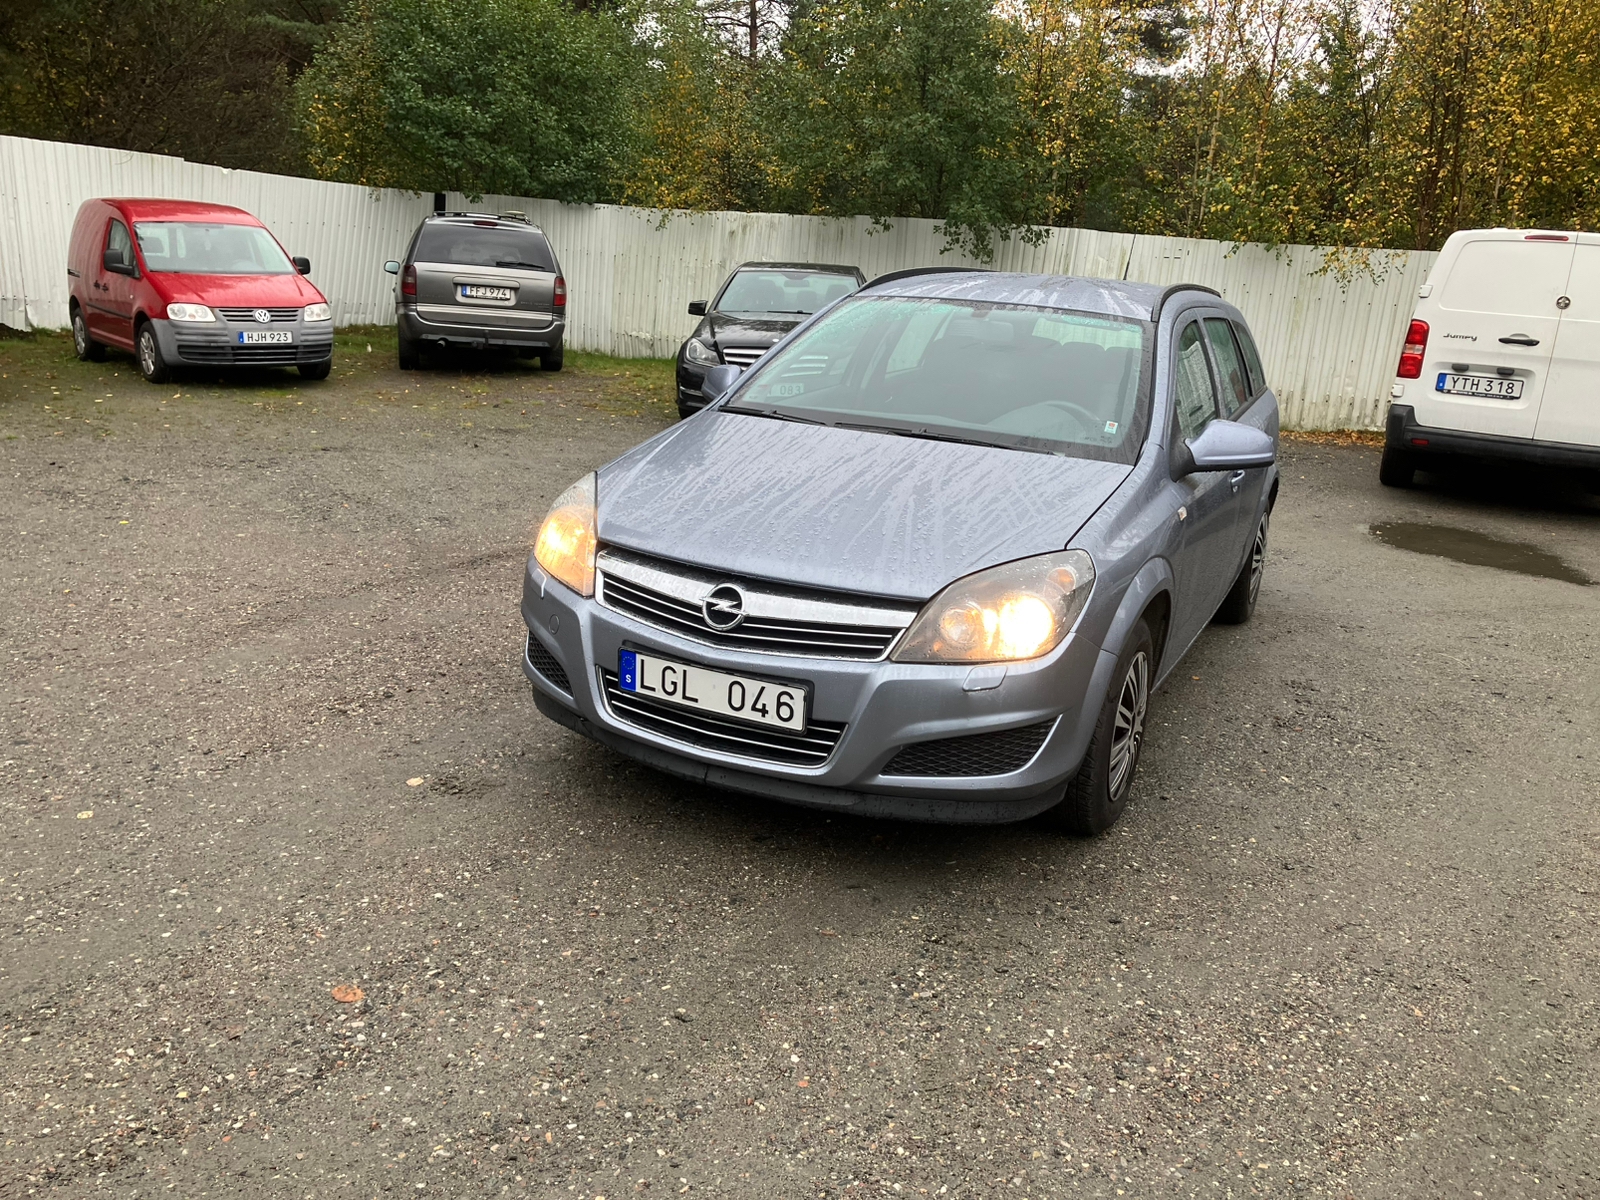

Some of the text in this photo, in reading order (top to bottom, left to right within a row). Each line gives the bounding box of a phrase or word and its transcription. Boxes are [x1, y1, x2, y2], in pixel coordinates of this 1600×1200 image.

[470, 286, 507, 297] FFJ 974
[247, 333, 289, 342] HJH 923
[779, 385, 801, 396] 083
[1451, 376, 1481, 391] YTH
[1484, 380, 1515, 395] 318
[625, 674, 632, 683] S
[640, 659, 795, 723] LGL 046
